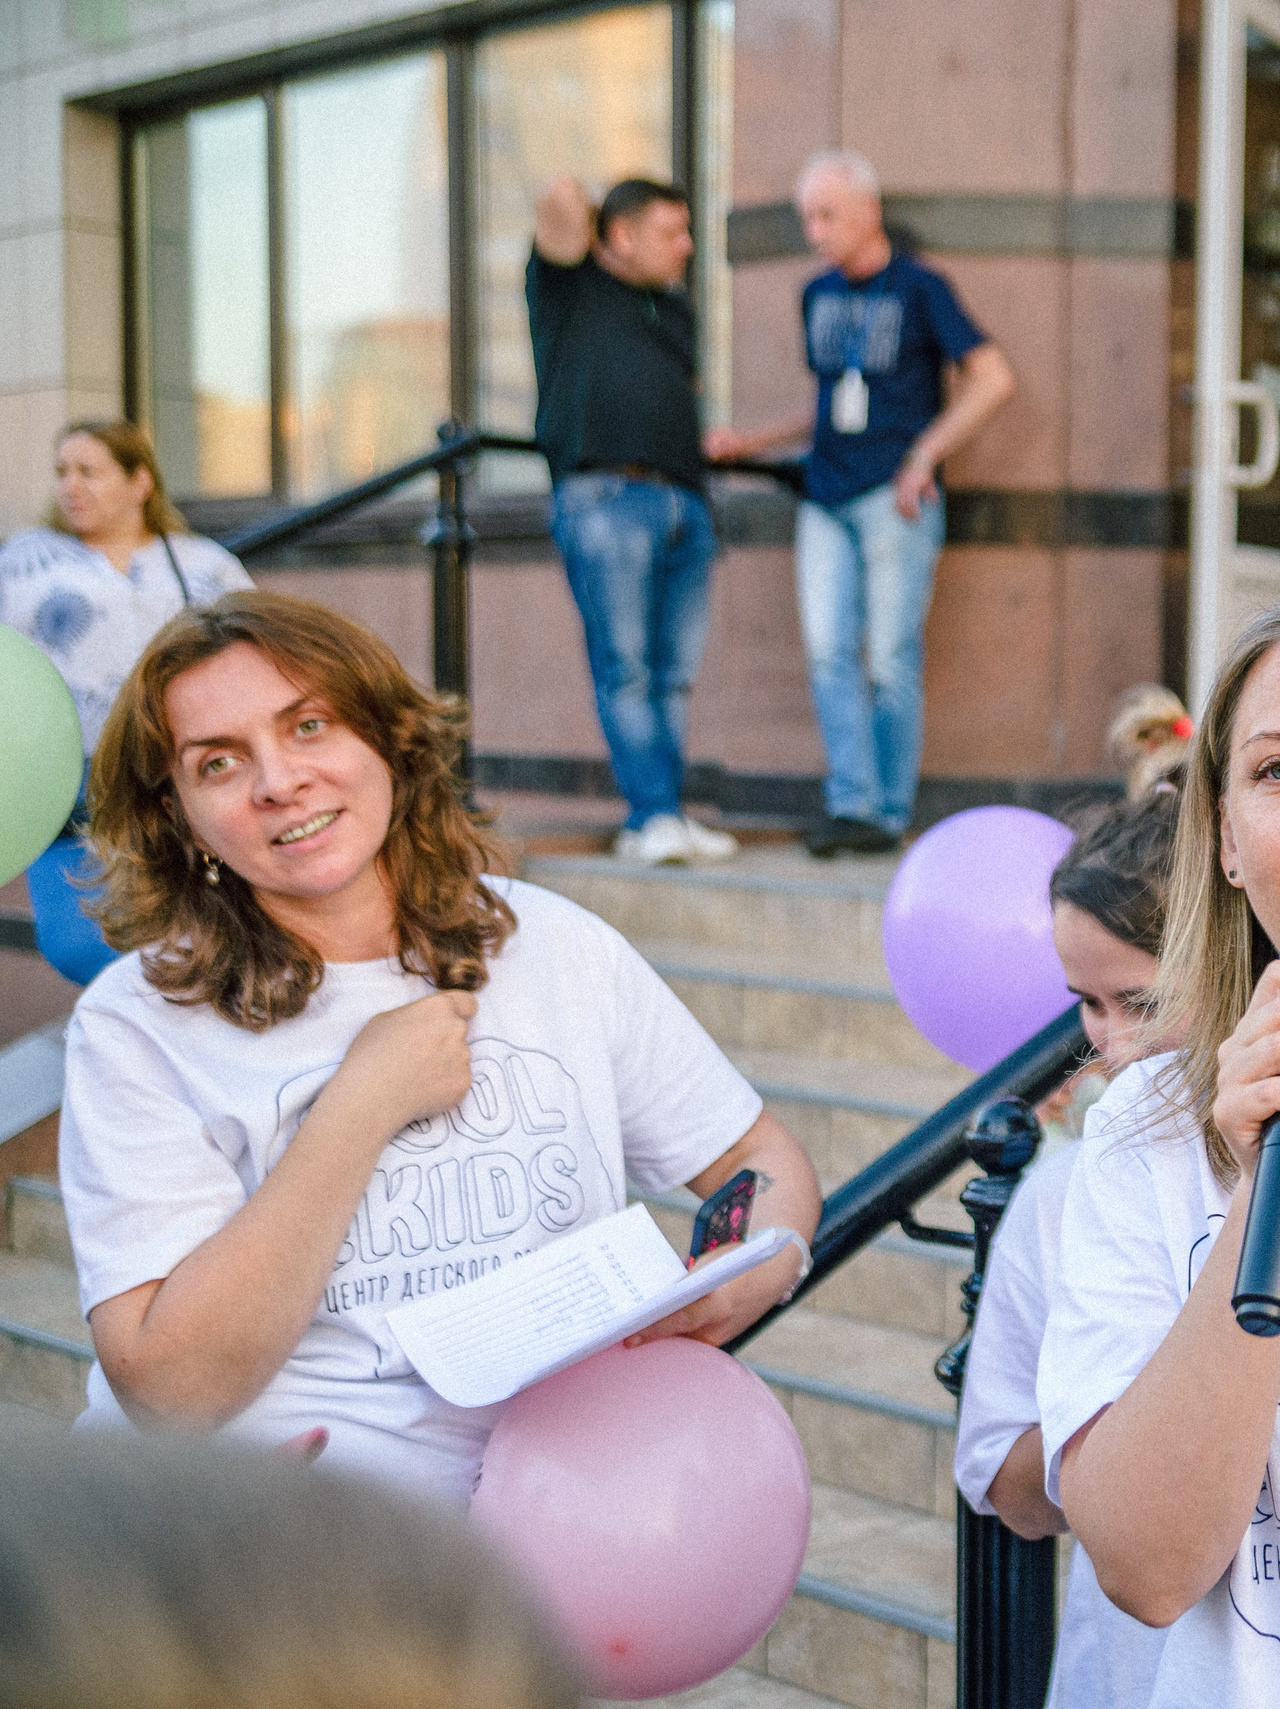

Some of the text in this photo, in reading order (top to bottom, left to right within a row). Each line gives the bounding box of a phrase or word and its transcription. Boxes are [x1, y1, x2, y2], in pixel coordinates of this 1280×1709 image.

[388, 1054, 568, 1154] OL
[335, 1142, 585, 1271] KIDS
[324, 1274, 389, 1315] ЦЕНТР
